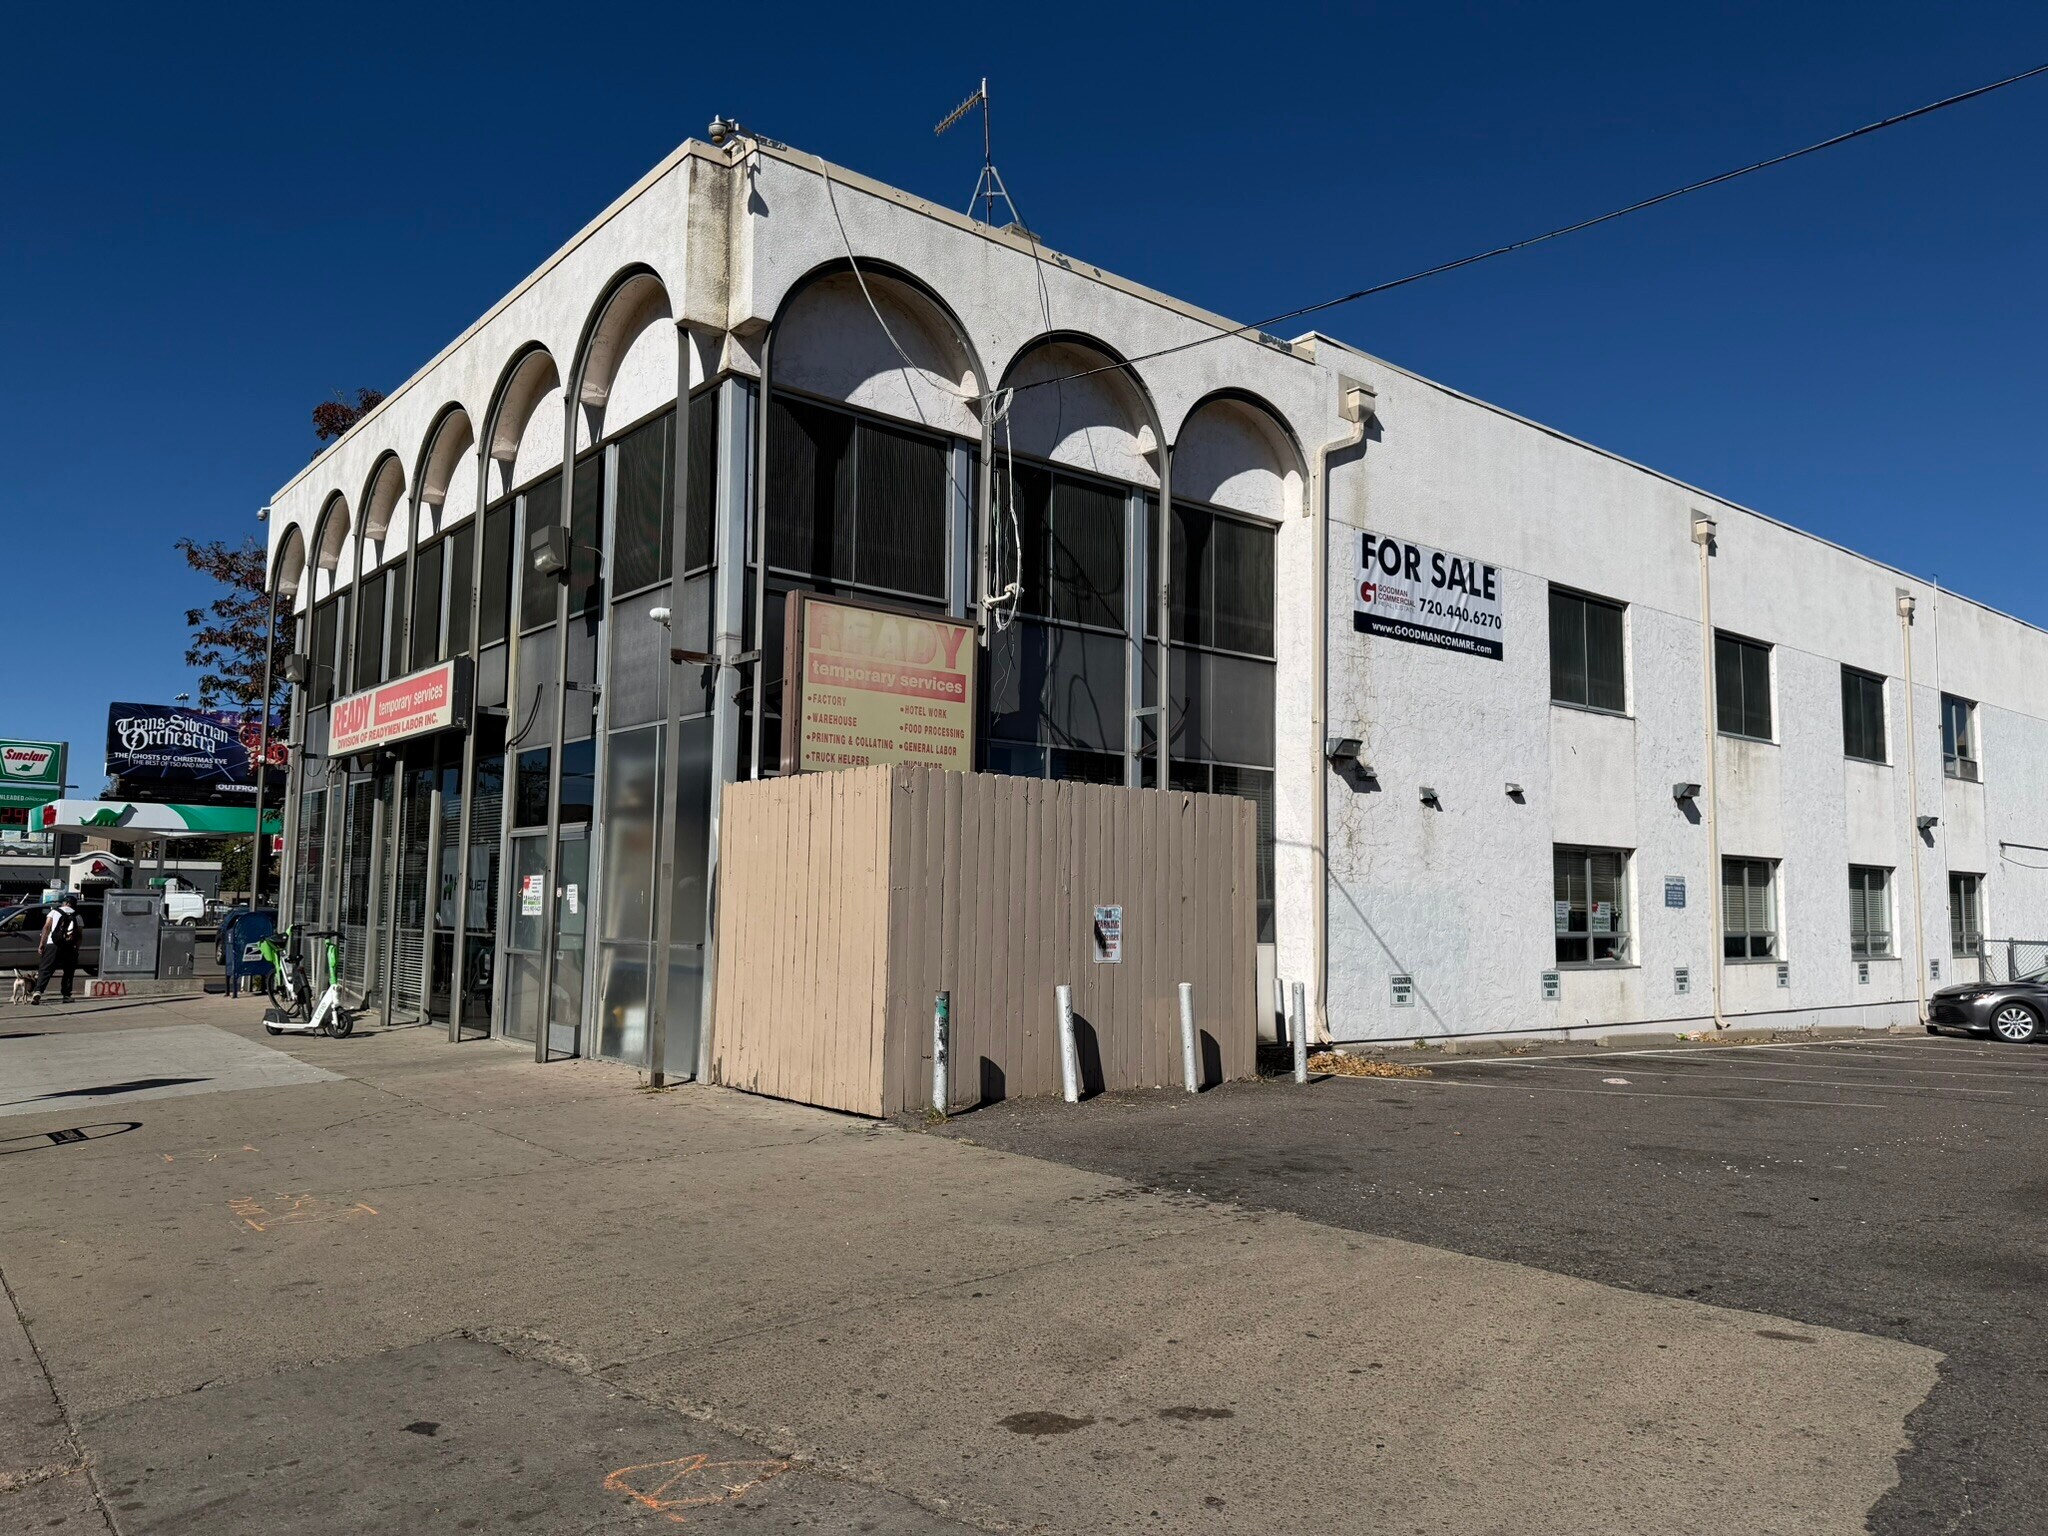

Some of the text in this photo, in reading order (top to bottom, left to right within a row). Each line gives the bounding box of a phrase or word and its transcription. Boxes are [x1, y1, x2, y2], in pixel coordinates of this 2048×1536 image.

[1362, 532, 1496, 602] FOR SALE
[1378, 584, 1408, 597] GOODMAN
[1419, 597, 1501, 630] 720.440.6270
[809, 602, 967, 670] READY
[1372, 622, 1492, 655] www.GOODMANCOMMRE.com
[812, 659, 963, 694] temporary services
[378, 683, 443, 717] temporary services
[812, 693, 847, 707] FACTORY
[332, 693, 373, 739] READY
[812, 712, 857, 727] WAREHOUSE
[904, 704, 948, 719] HOTEL WORK
[115, 714, 229, 743] Trans-Siberian
[337, 712, 438, 749] DIVISION OF READYMEN LABOR INC.
[904, 723, 965, 739] FOOD PROCESSING
[122, 727, 217, 754] Orchestra
[811, 732, 894, 750] PRINTING & COLLATING
[903, 742, 957, 756] GENERAL LABOR
[4, 749, 49, 762] Sinclair
[132, 753, 161, 761] GHOSTS
[173, 756, 213, 764] CHRISTMAS
[811, 751, 870, 766] TRUCK HELPERS
[217, 784, 259, 793] OUTFRON
[1393, 985, 1410, 993] PARKING
